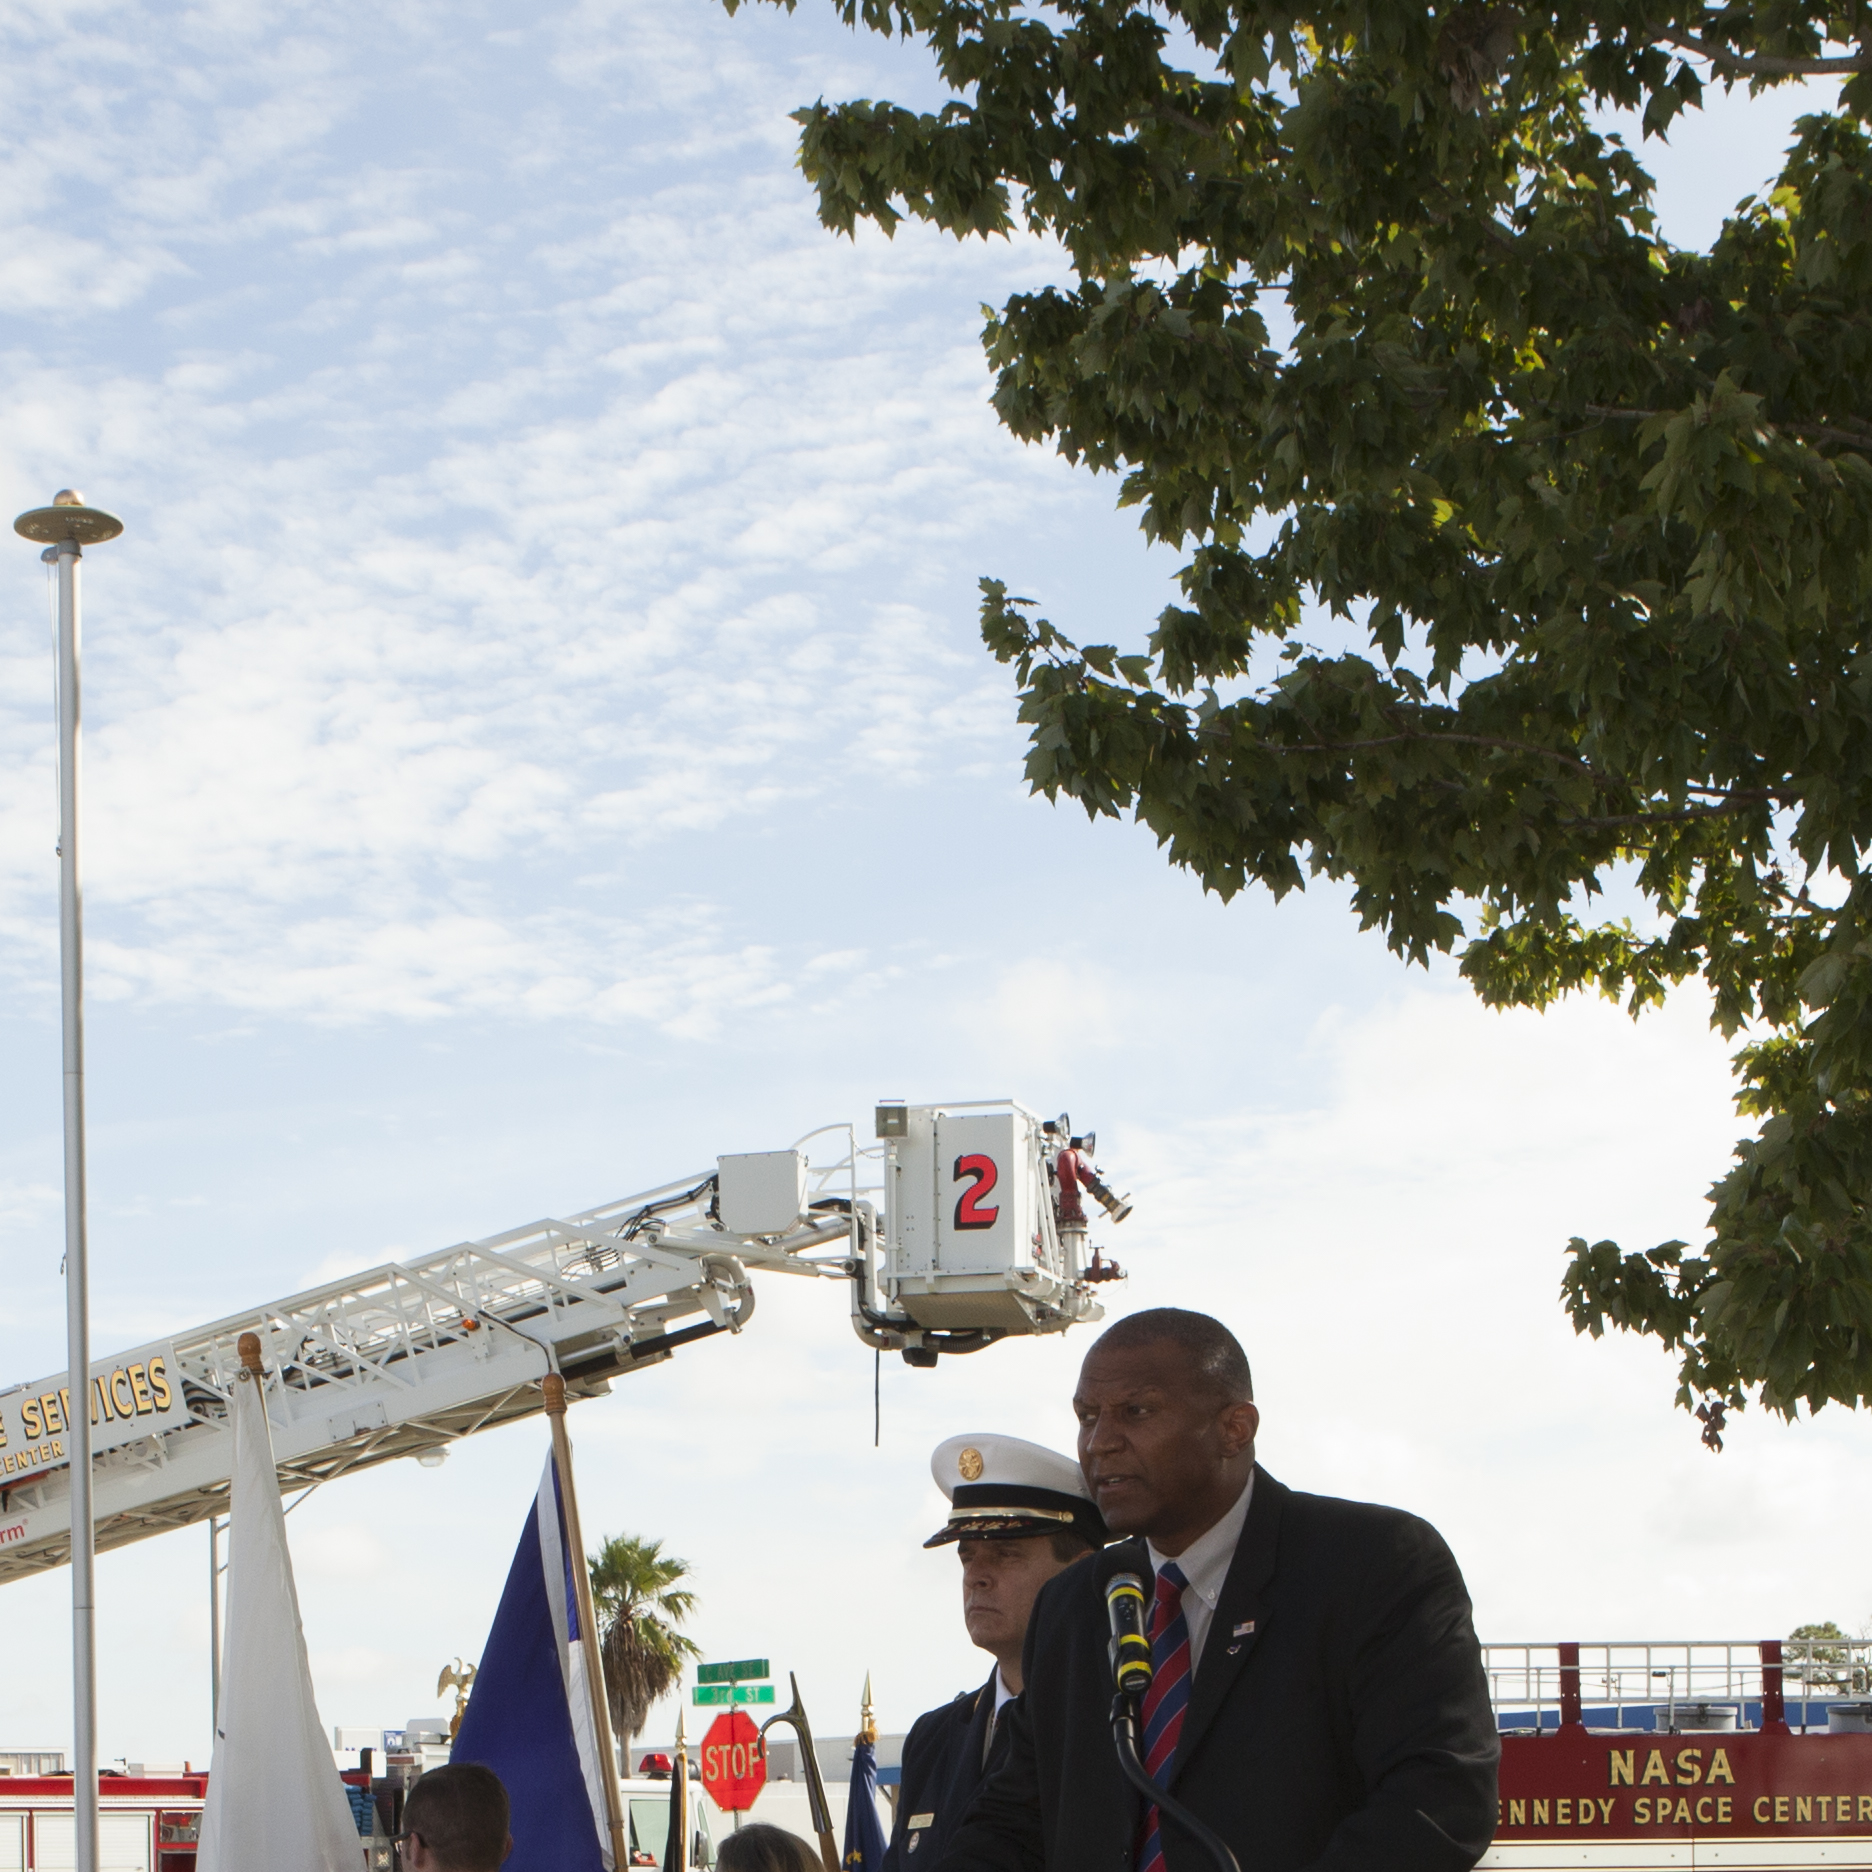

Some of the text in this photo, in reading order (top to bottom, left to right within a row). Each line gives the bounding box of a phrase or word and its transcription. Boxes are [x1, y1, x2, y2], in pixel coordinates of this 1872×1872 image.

[953, 1153, 1000, 1231] 2
[21, 1356, 173, 1441] SEICES
[711, 1687, 759, 1703] 3rd ST
[705, 1742, 763, 1781] STOP
[1609, 1748, 1736, 1787] NASA
[1498, 1797, 1616, 1826] NNEDY
[1633, 1796, 1733, 1825] SPACE
